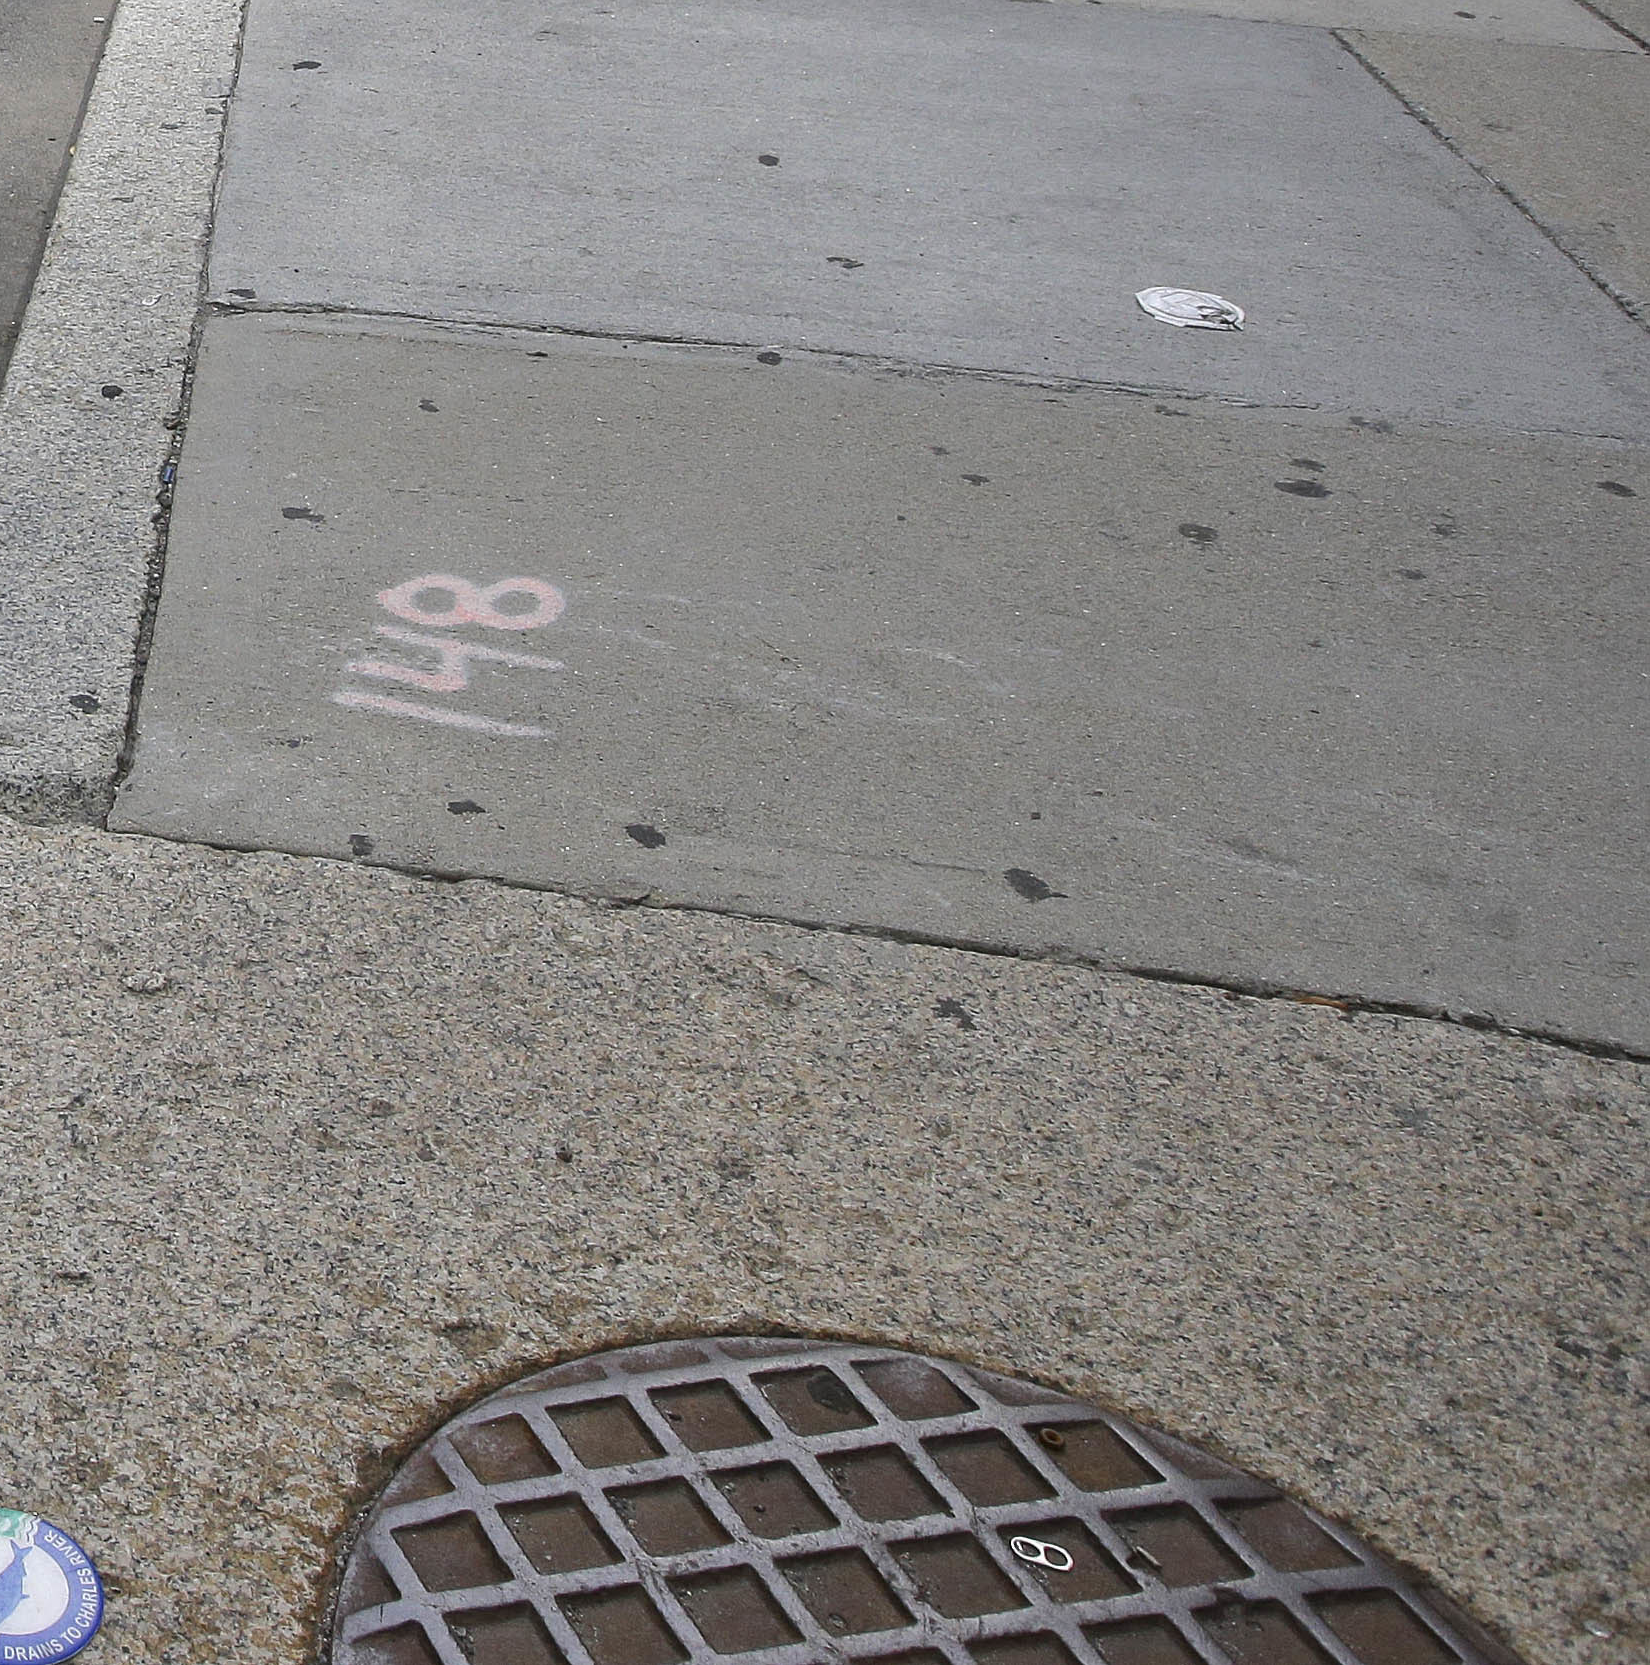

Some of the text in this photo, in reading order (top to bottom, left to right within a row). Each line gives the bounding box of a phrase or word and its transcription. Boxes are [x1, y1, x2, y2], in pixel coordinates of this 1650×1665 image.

[4, 1530, 99, 1661] DRAINS TO CHARLES RIVER
